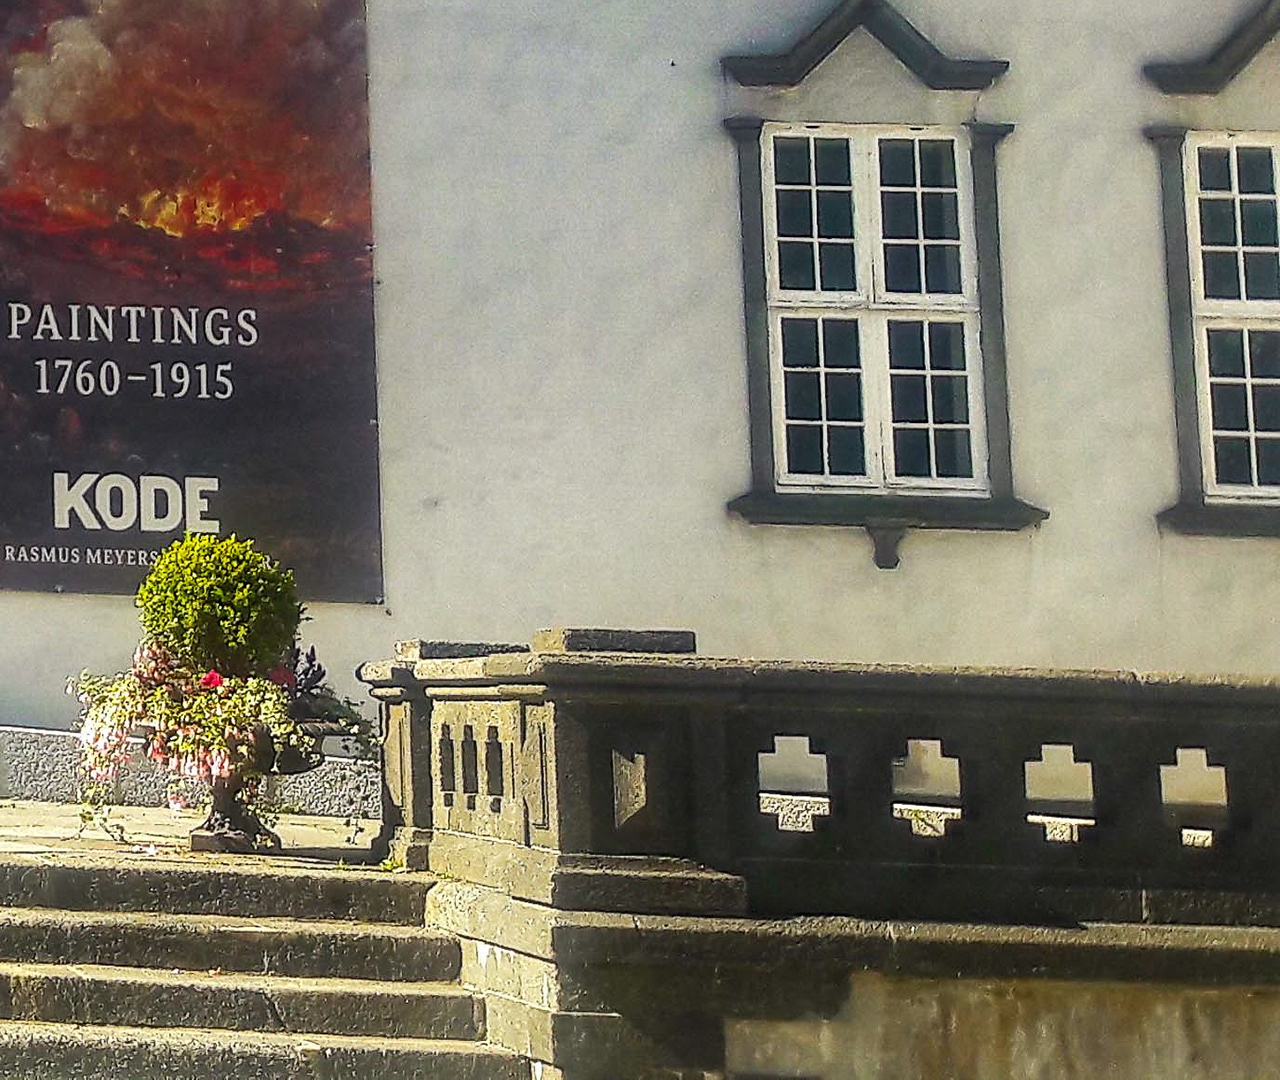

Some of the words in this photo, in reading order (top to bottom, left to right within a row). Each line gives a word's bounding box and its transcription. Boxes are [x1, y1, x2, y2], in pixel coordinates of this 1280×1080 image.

[7, 302, 259, 347] PAINTINGS
[53, 472, 220, 534] KODE
[4, 545, 80, 564] RASMUS
[86, 546, 159, 566] MEYERS
